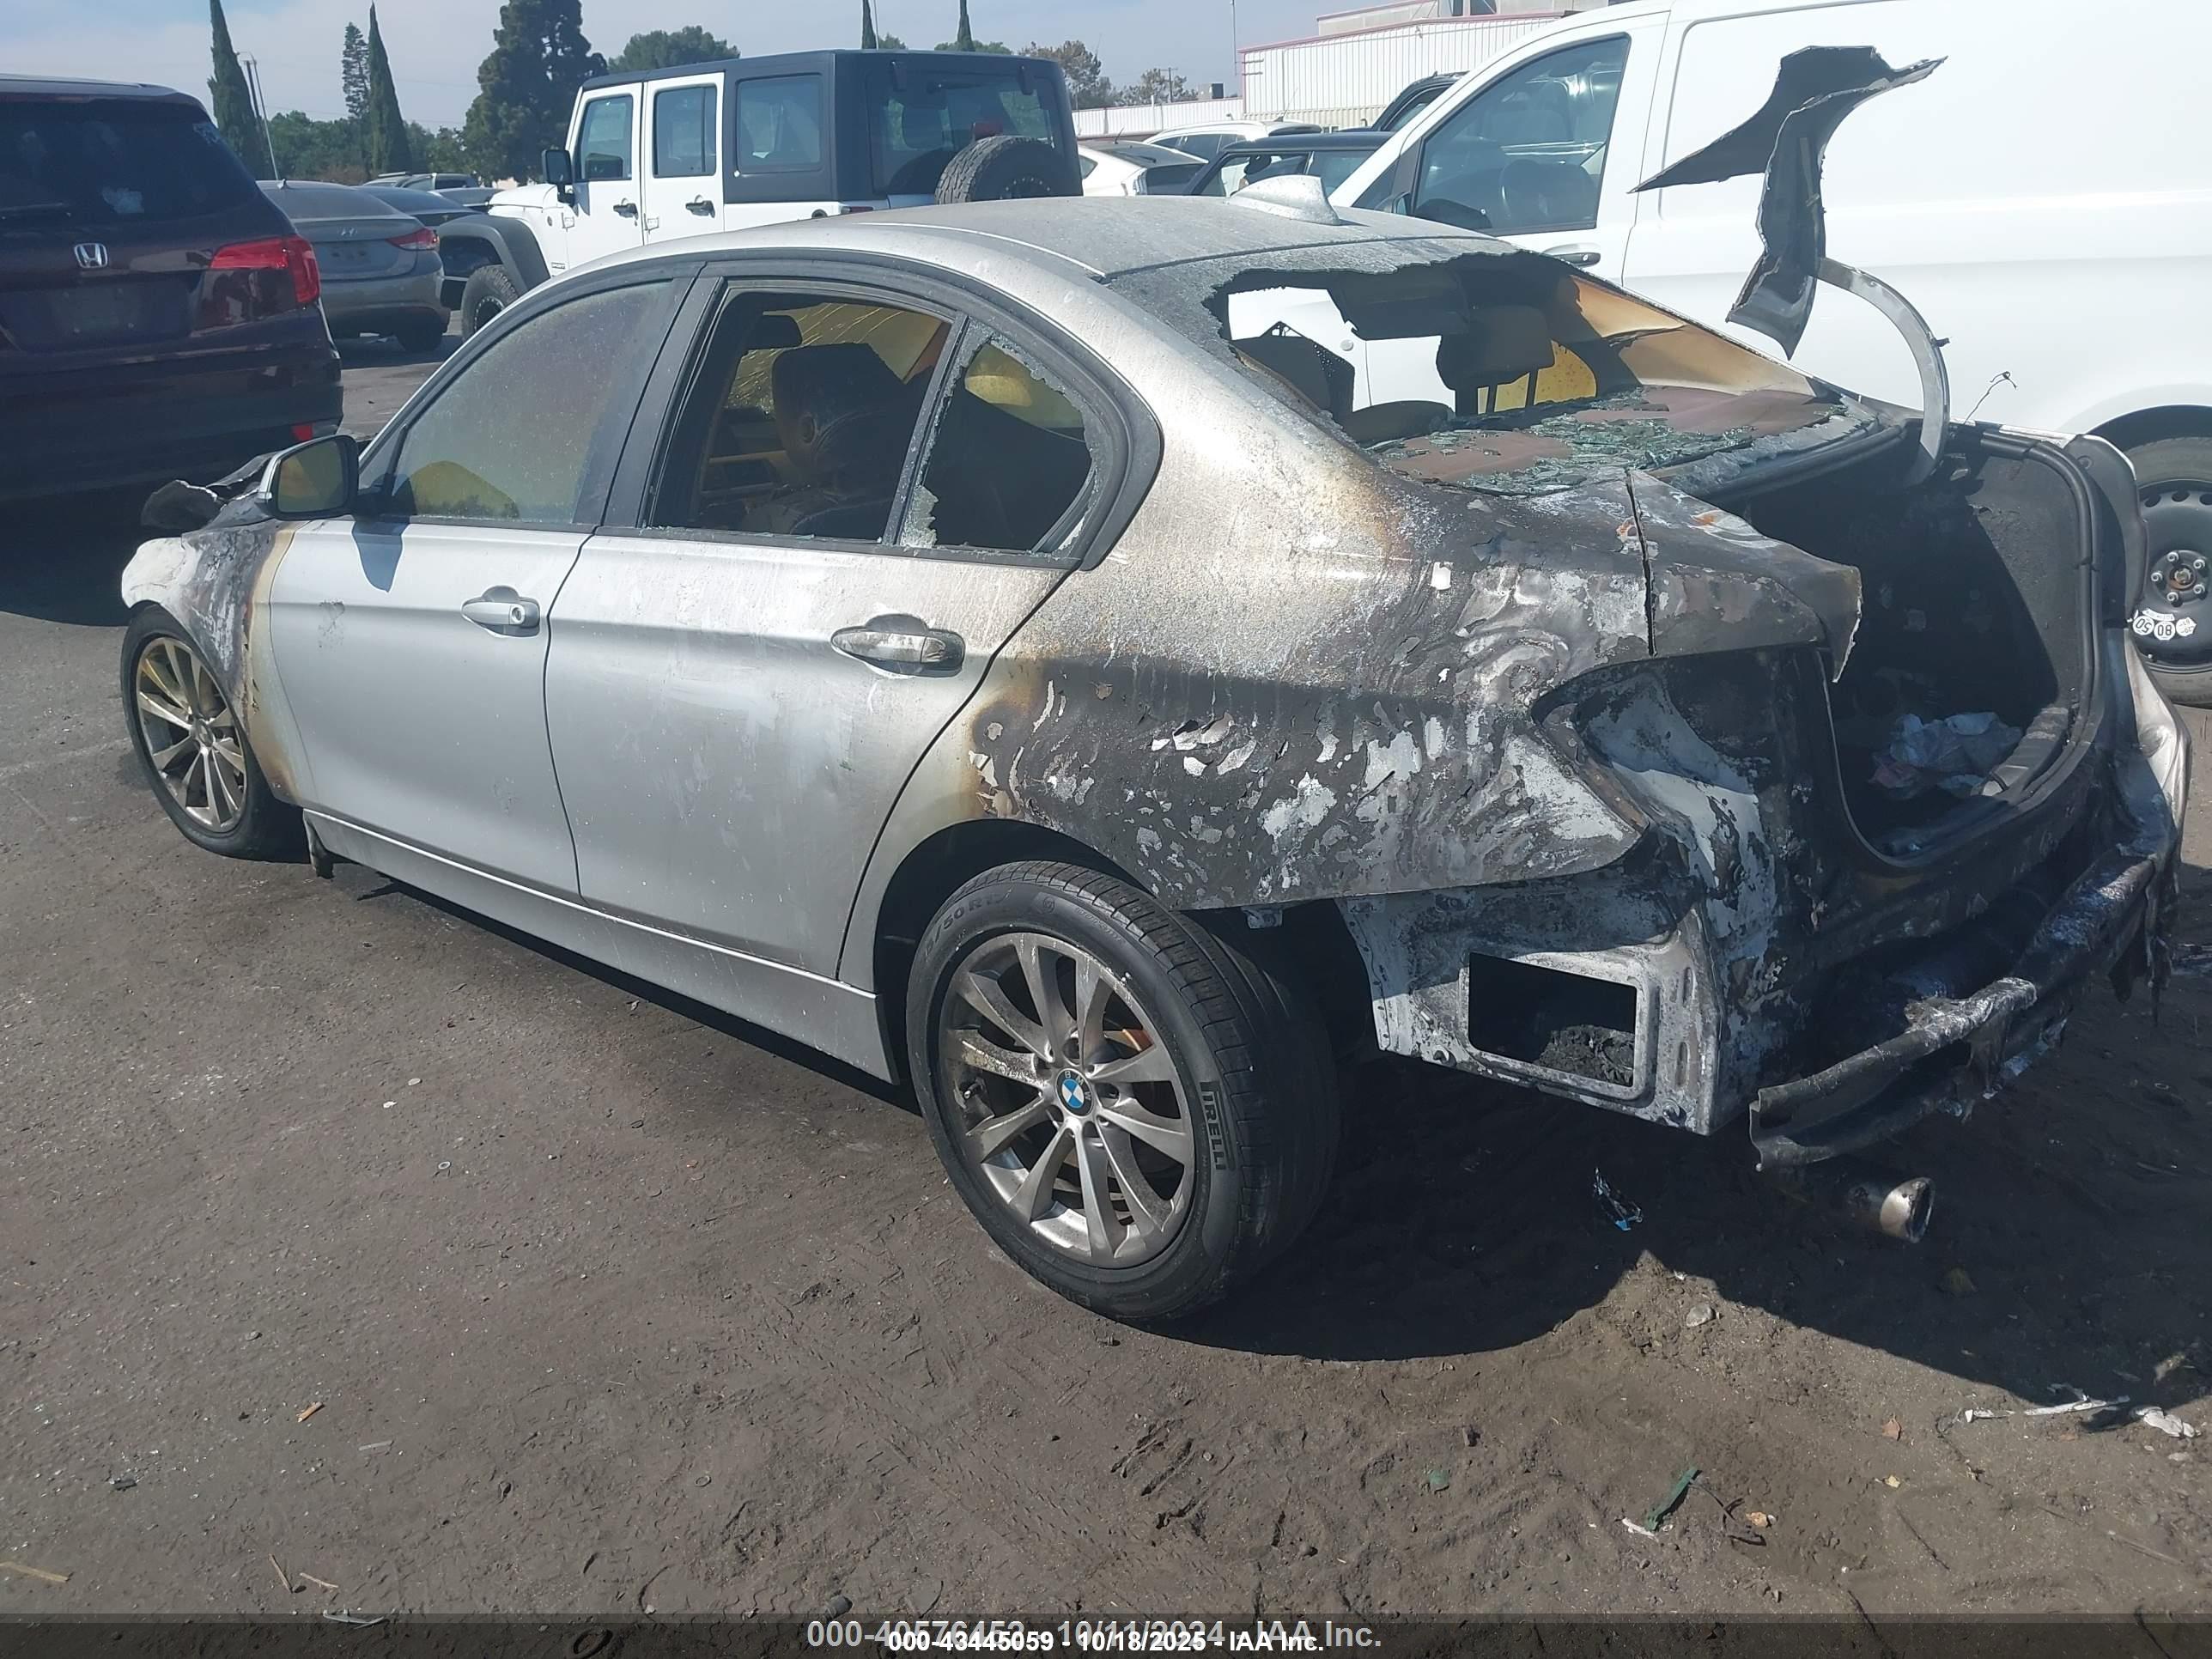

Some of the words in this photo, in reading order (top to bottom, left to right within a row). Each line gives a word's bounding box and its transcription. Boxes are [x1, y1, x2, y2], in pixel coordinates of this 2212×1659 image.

[2136, 618, 2152, 633] 50
[1064, 1070, 1091, 1101] BMW
[1200, 1081, 1235, 1170] PIRELLI
